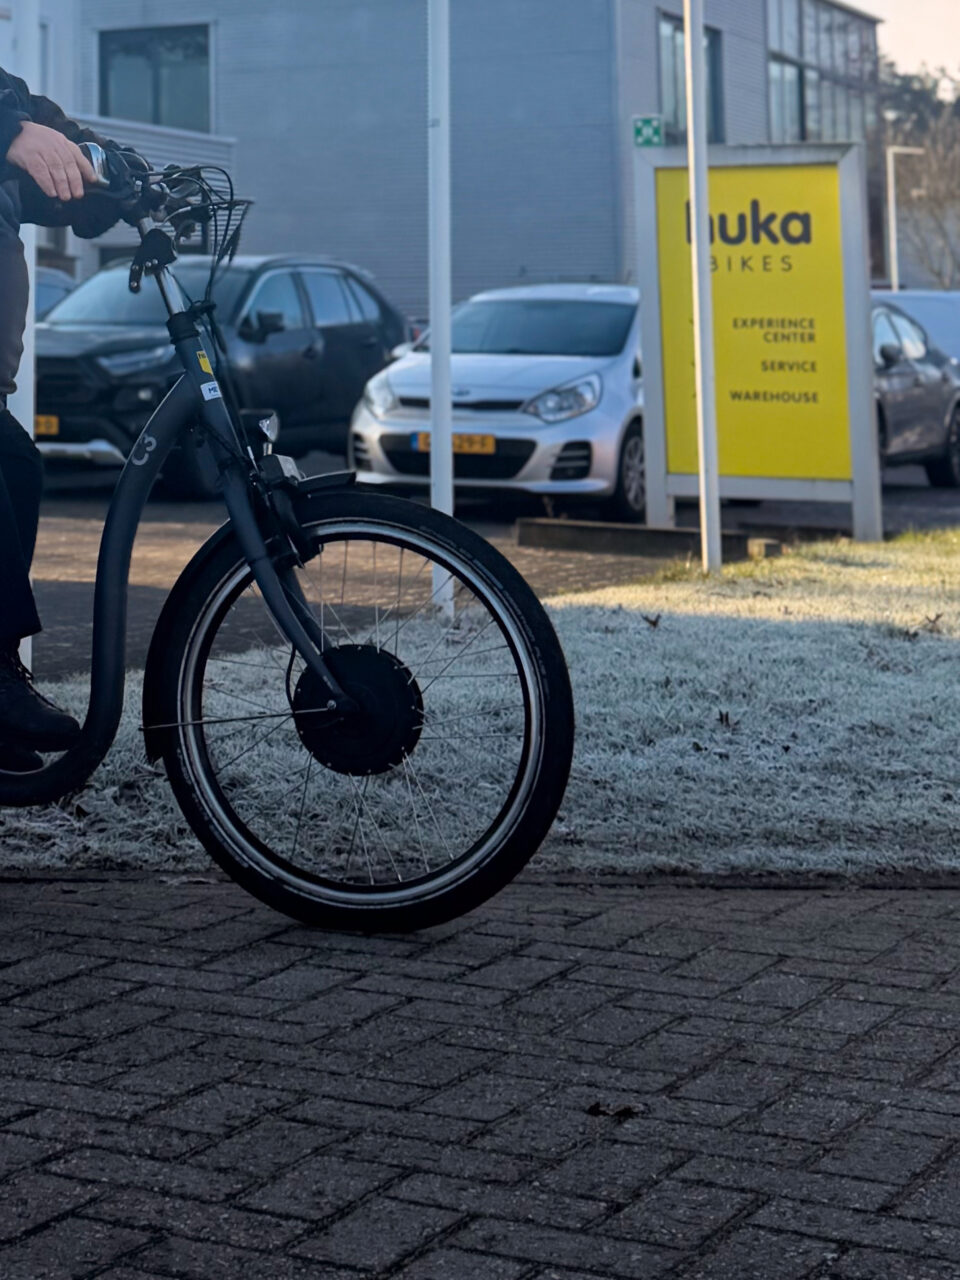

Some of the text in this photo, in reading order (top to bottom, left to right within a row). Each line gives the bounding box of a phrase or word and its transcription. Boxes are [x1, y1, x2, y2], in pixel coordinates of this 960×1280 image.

[732, 317, 816, 331] EXPERIENCE
[763, 331, 816, 344] CENTER
[761, 360, 817, 373] SERVICE
[729, 390, 819, 404] WAREHOUSE
